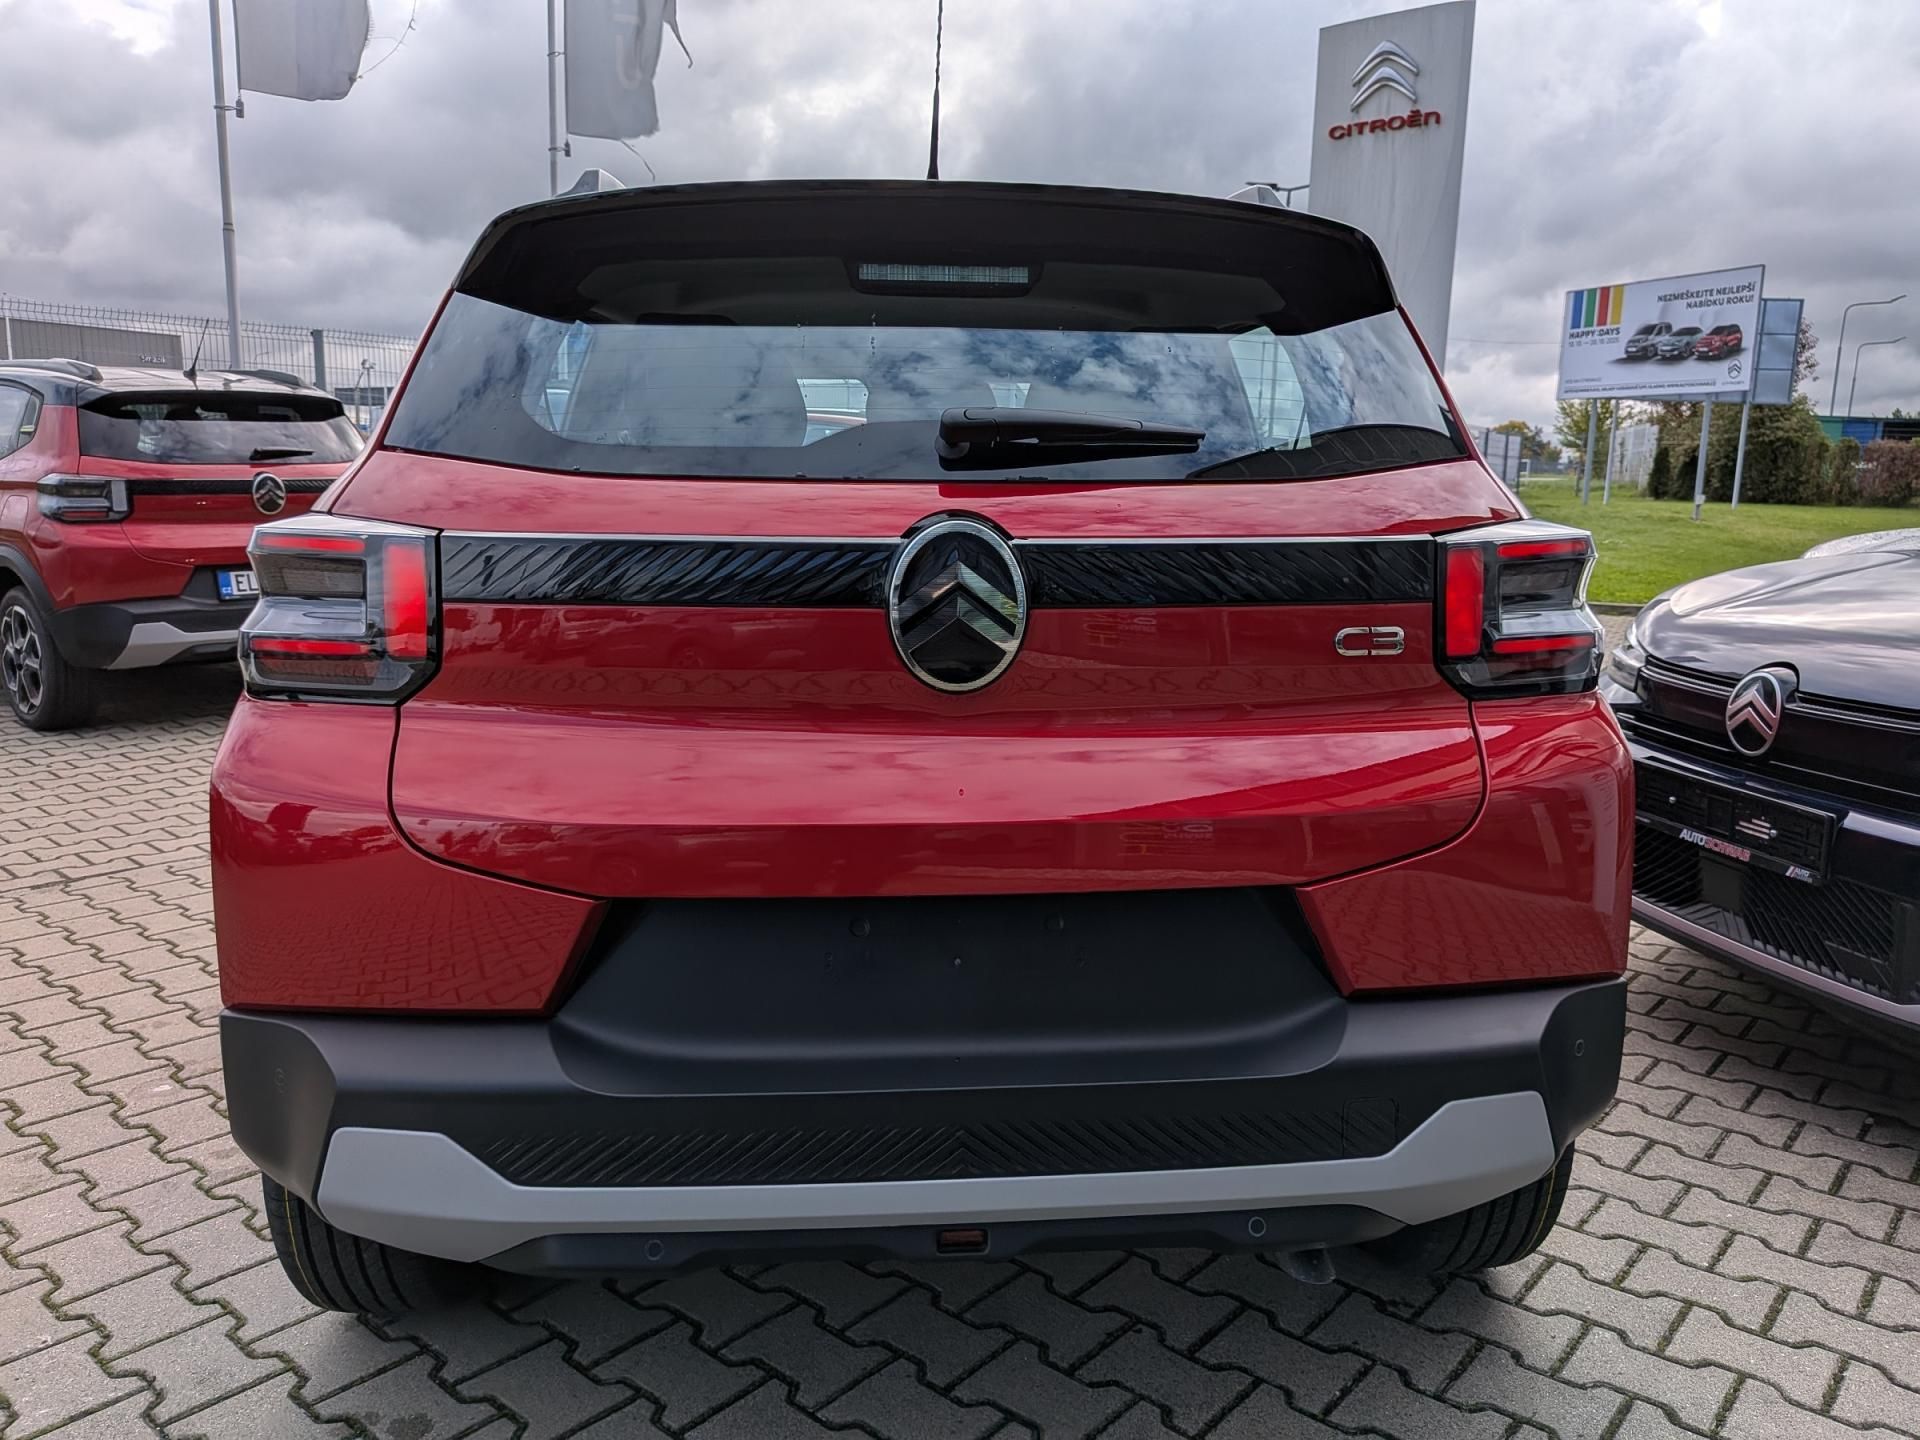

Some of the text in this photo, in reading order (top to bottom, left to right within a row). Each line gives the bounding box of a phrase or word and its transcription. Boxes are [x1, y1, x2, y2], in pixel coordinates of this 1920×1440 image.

[1716, 281, 1756, 296] NEJLEPŠÍ
[1686, 294, 1754, 310] NABÍDKU ROKU!
[1568, 330, 1596, 340] HAPPY
[1335, 626, 1404, 657] C3
